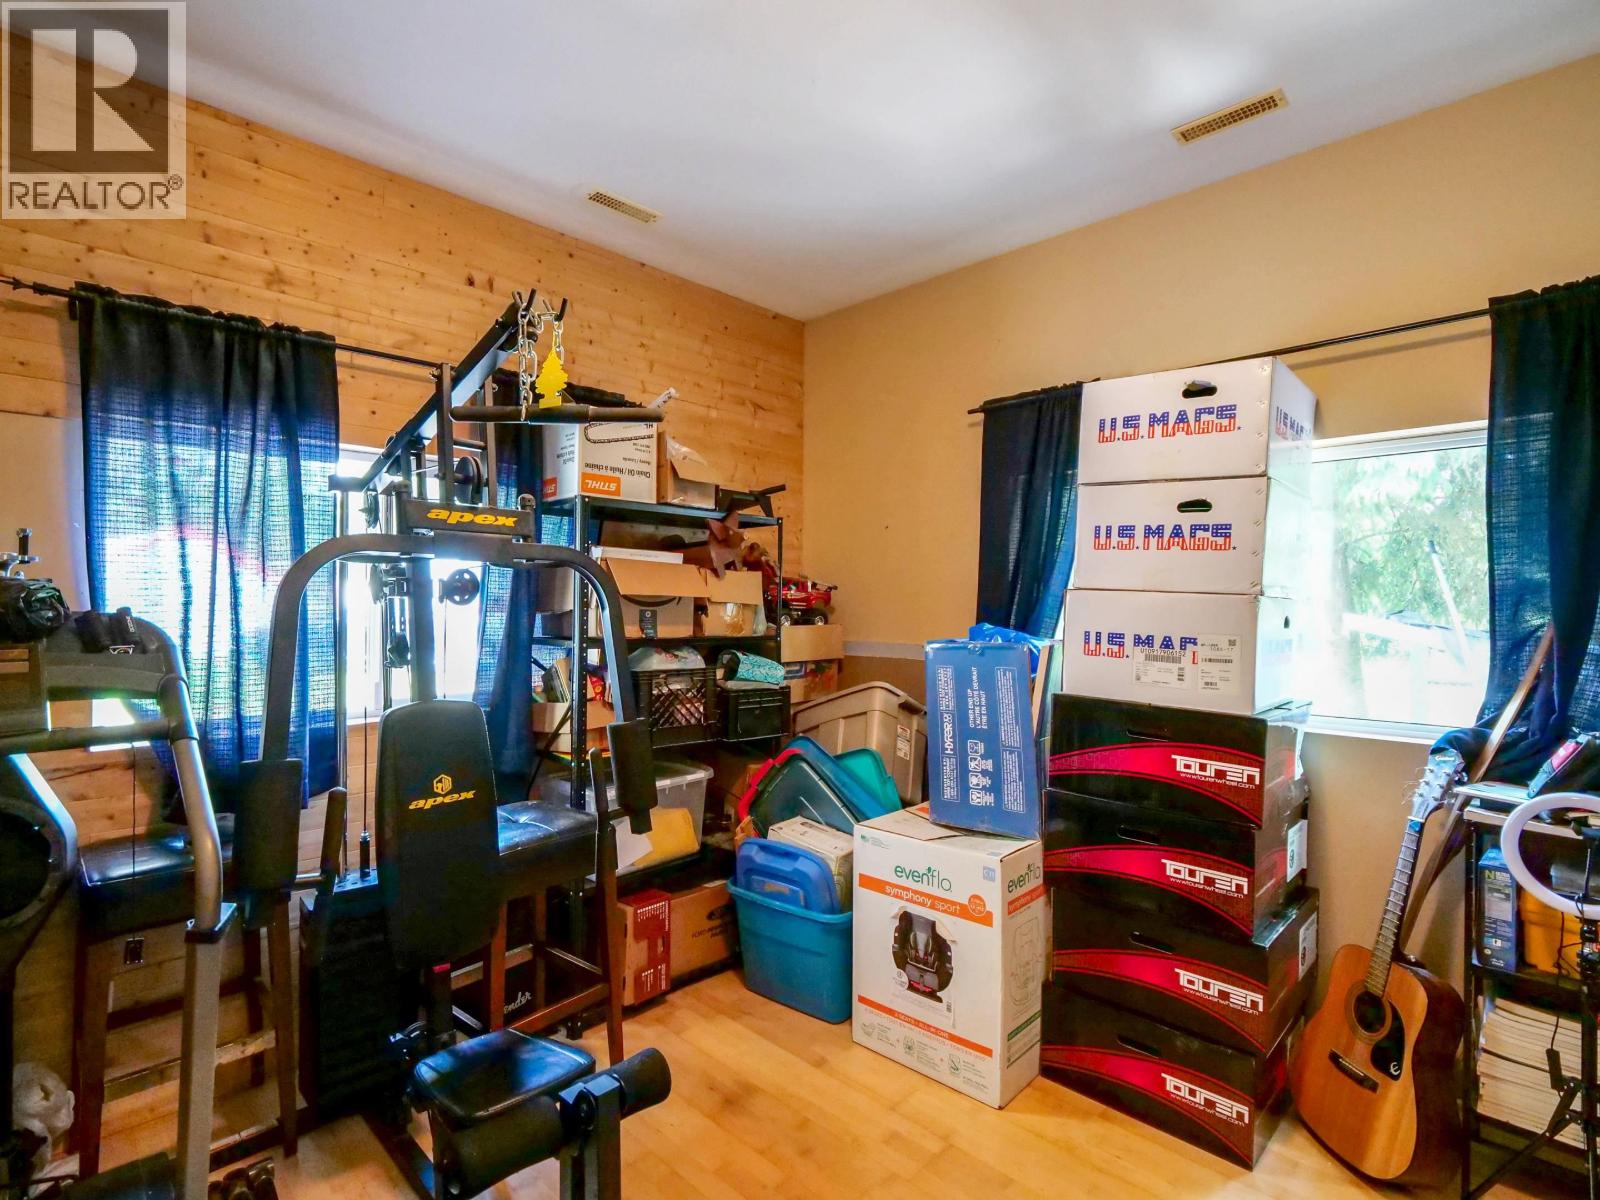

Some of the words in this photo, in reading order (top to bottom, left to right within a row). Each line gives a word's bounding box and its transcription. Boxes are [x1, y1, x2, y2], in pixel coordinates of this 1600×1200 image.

[584, 479, 617, 492] STIHL
[635, 470, 651, 479] Chain
[426, 507, 519, 529] apex
[408, 787, 476, 811] apex
[894, 865, 952, 893] evenflo
[885, 884, 932, 908] symphony
[934, 899, 961, 915] sport
[503, 991, 534, 1014] ender
